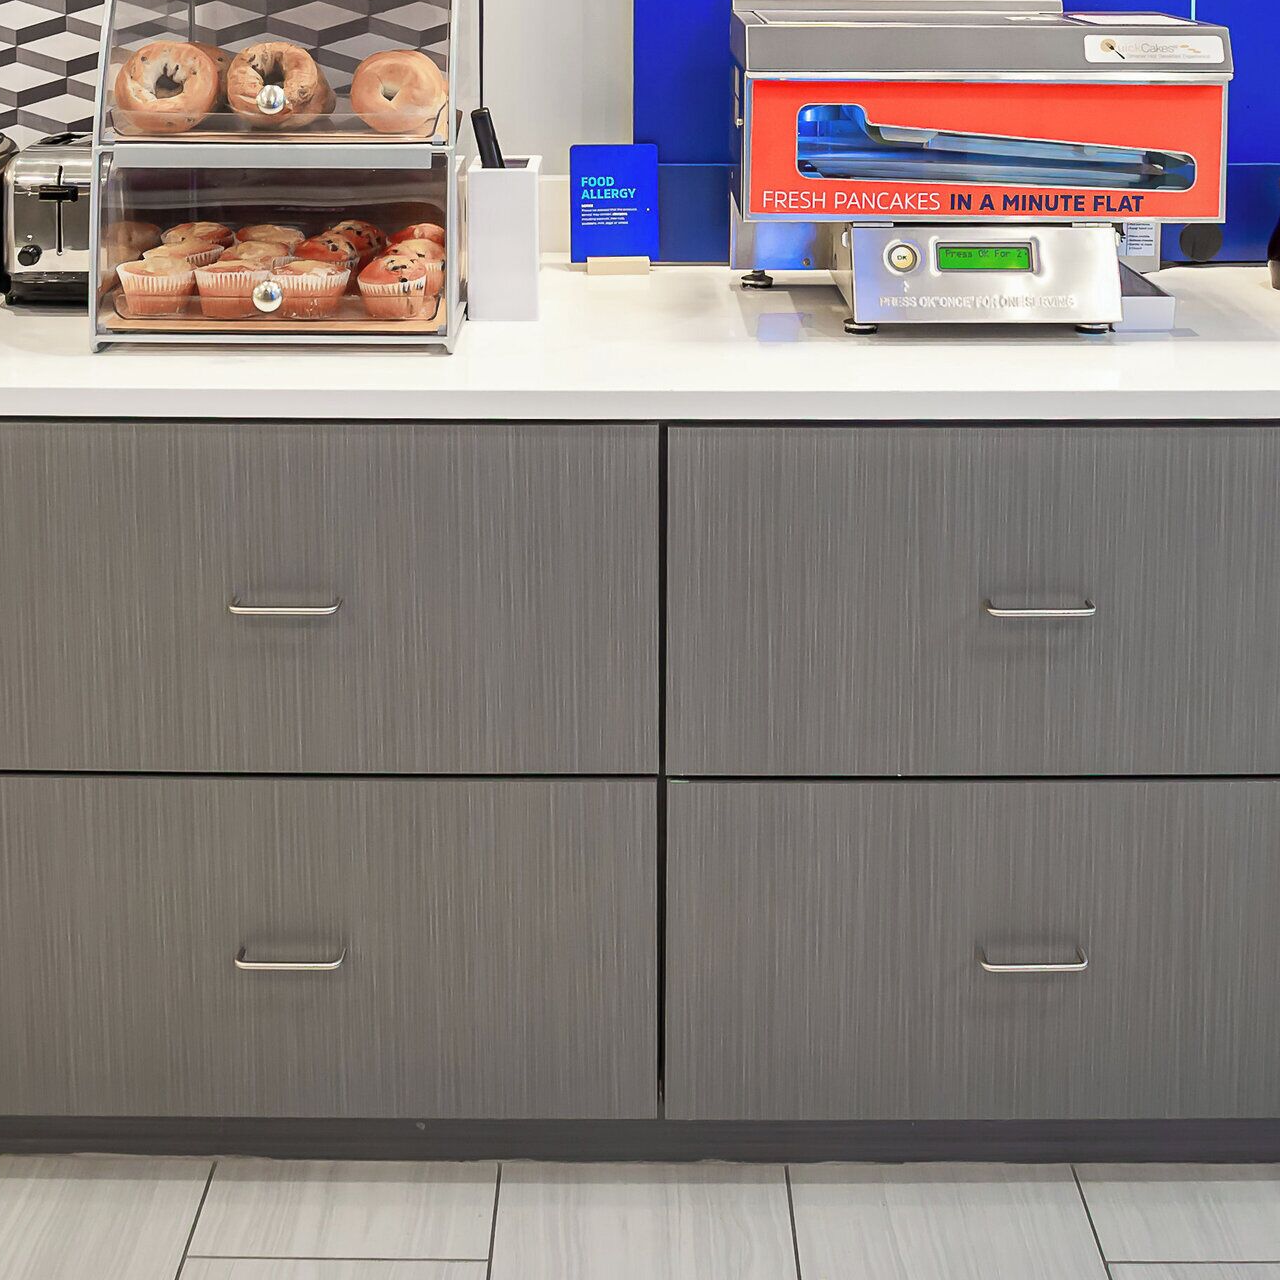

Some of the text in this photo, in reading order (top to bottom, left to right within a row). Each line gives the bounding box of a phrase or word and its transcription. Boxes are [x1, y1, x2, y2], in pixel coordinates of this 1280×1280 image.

[581, 176, 615, 188] FOOD
[581, 188, 636, 200] ALLERGY
[763, 190, 1144, 212] FRESH PANCAKES IN A MINUTE FLAT
[945, 249, 973, 258] Press
[994, 249, 1010, 258] For
